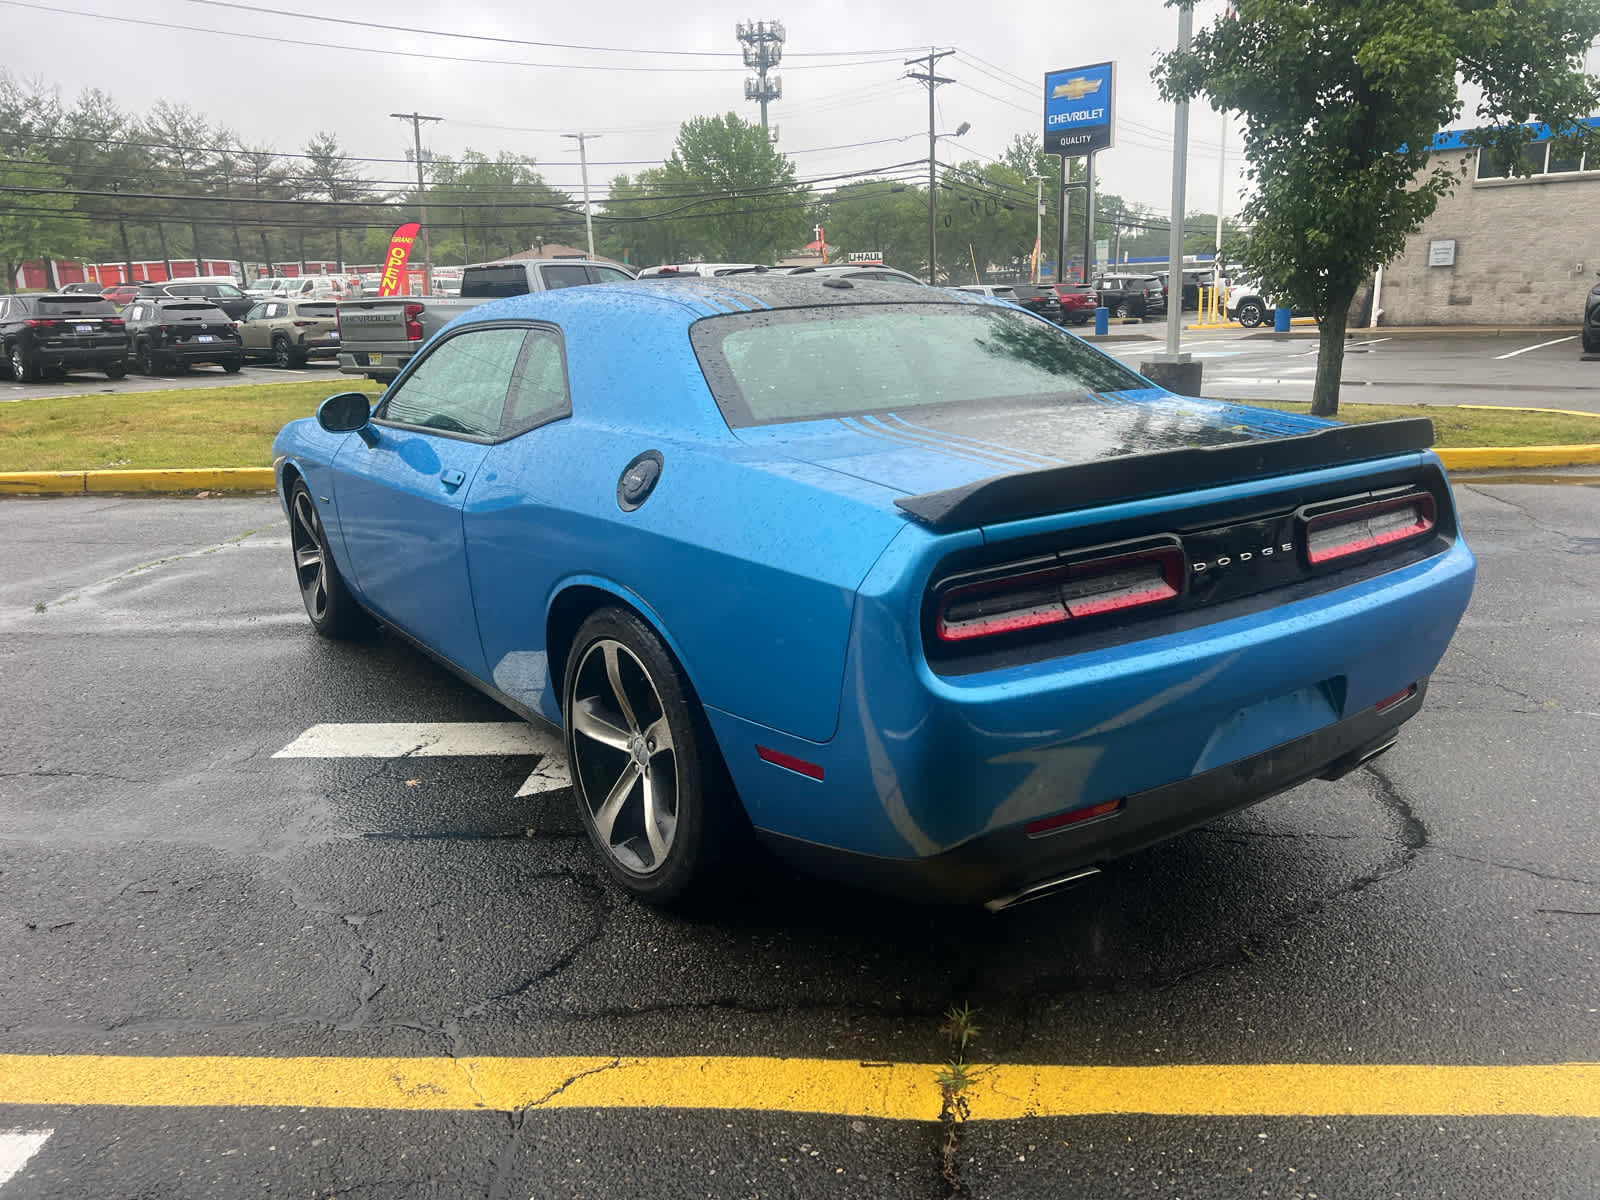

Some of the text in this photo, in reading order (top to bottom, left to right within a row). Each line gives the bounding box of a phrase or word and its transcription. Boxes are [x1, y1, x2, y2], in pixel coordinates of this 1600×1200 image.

[1048, 108, 1104, 125] CHEVROLET
[1060, 134, 1092, 146] QUALITY
[849, 252, 883, 262] U-HAUL
[382, 247, 406, 297] OPENI
[1192, 542, 1293, 572] DODGE
